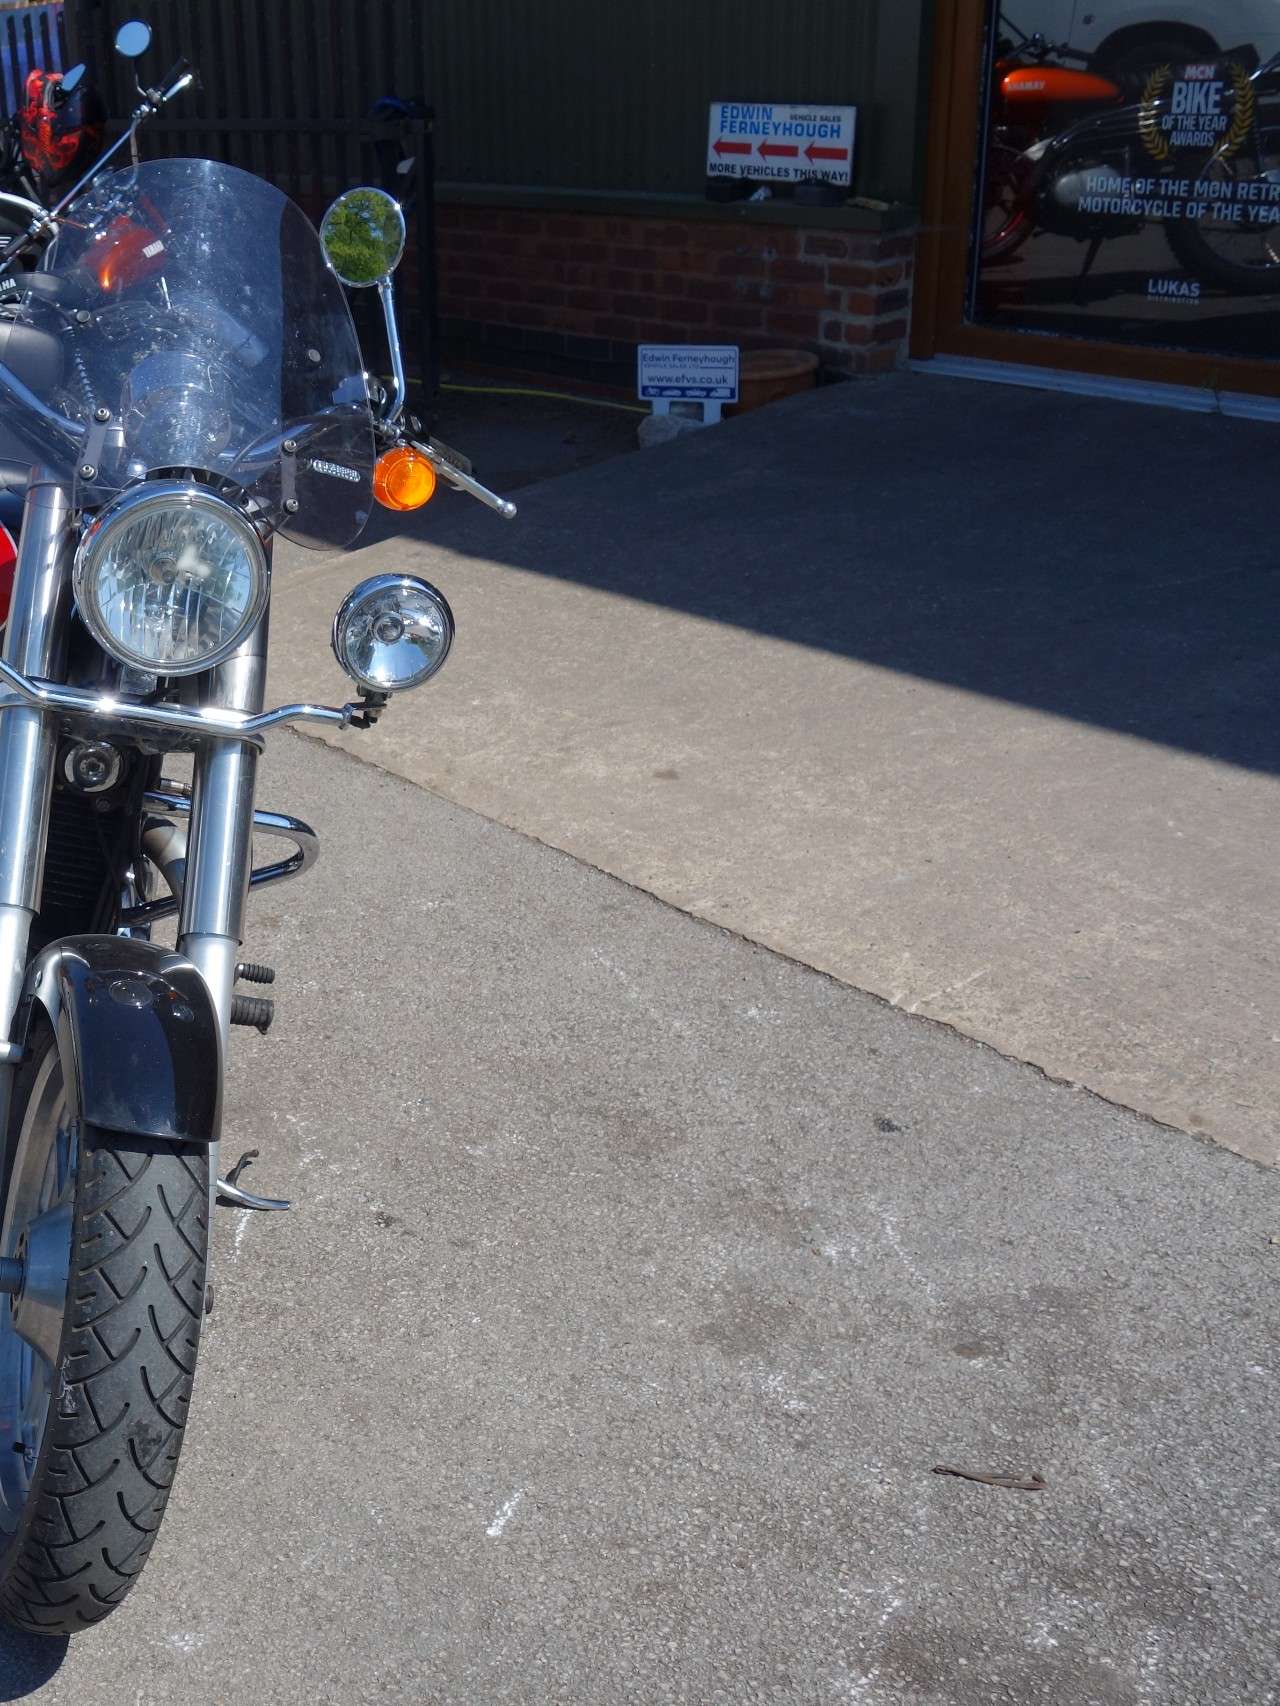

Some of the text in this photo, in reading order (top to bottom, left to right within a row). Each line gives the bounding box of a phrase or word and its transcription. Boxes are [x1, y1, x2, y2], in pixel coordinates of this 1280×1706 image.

[1171, 81, 1224, 115] BIKE
[720, 106, 773, 121] EDWIN
[790, 114, 818, 122] VEHICLE
[720, 120, 841, 139] FERNEYHOUGH
[1162, 115, 1228, 132] OF THE YEAR
[1169, 131, 1216, 146] AWARDS
[709, 162, 849, 182] MORE VEHICLES THIS WAY!
[1086, 176, 1132, 193] HOME
[1135, 178, 1156, 194] OF
[1159, 179, 1189, 196] THE
[1078, 196, 1181, 218] MOTORCYCLE
[1186, 202, 1209, 219] OF
[1212, 202, 1244, 221] THE
[1148, 279, 1201, 297] LUKAS
[642, 353, 736, 365] Edwin Ferneyhough
[647, 374, 728, 385] www.efvs.co.uk
